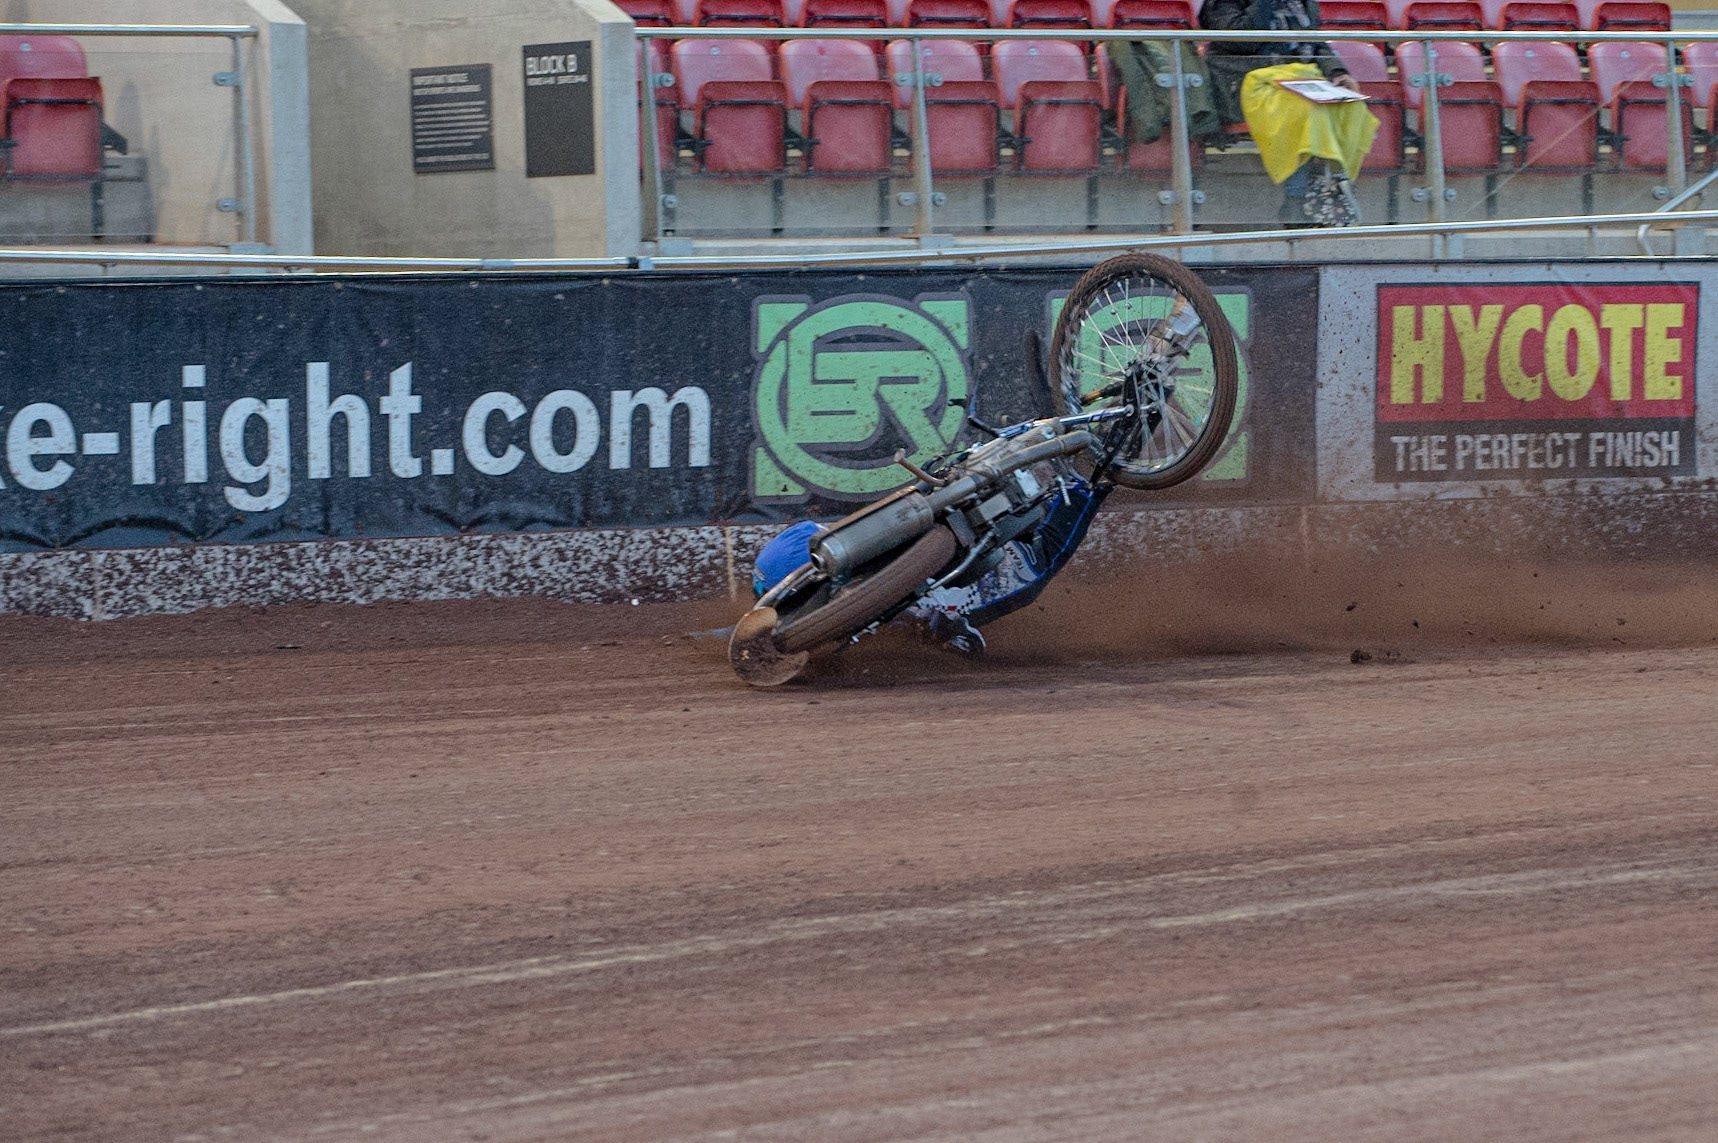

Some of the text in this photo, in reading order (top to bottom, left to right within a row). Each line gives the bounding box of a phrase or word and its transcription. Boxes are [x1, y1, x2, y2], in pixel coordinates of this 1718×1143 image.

[526, 54, 566, 76] BLOCK
[1390, 303, 1685, 404] HYCOTE
[0, 361, 711, 512] e-right.com
[1390, 430, 1681, 472] THE PERFECT FINISH
